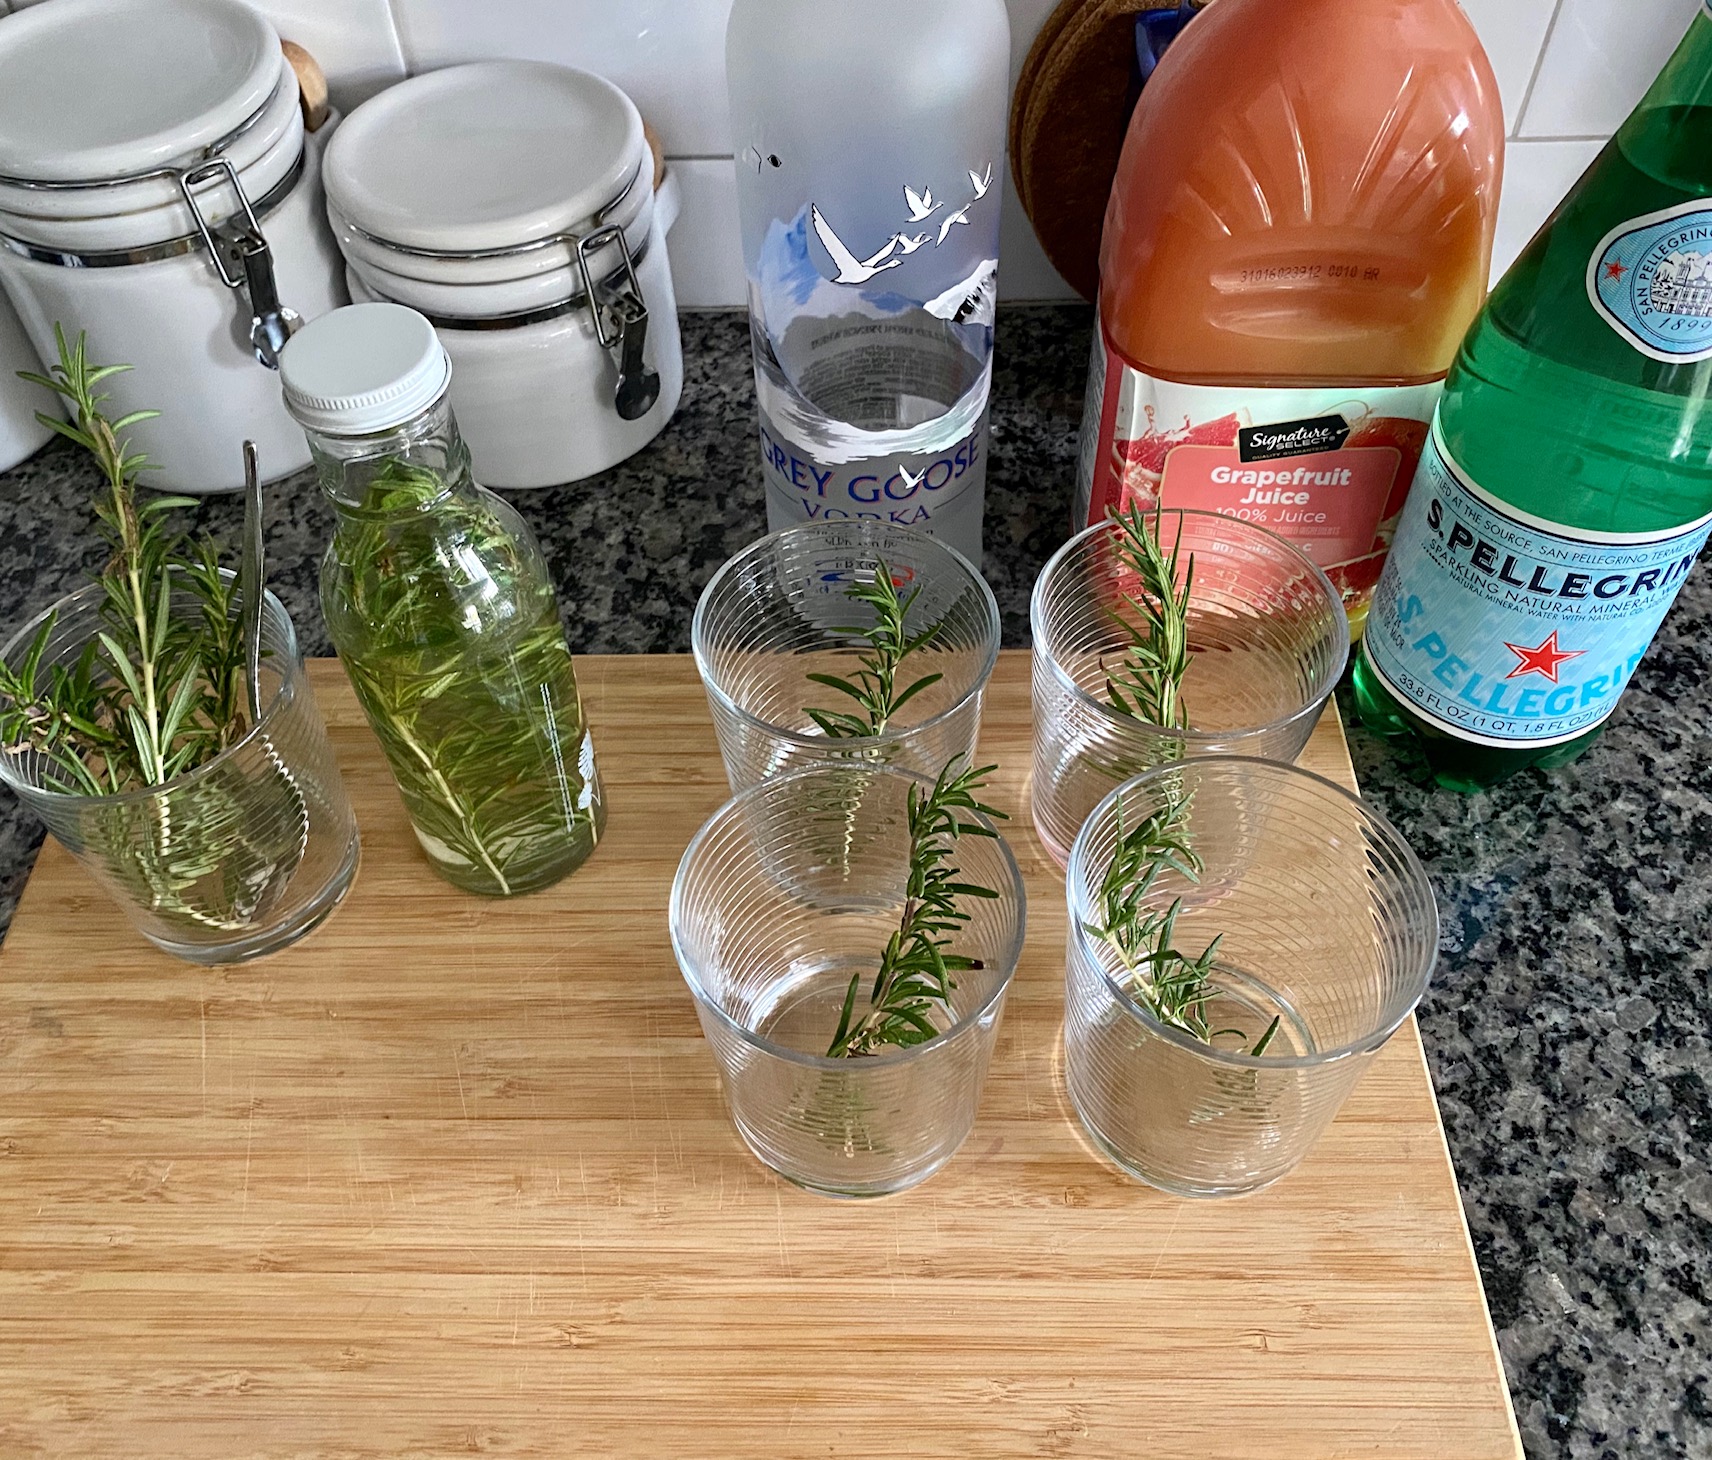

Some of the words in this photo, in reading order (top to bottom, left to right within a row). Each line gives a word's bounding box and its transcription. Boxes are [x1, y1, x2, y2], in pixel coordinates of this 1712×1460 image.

[1639, 228, 1712, 280] PELLEGRIN
[1637, 287, 1653, 316] SAN
[1658, 317, 1712, 332] 1899
[1250, 427, 1331, 450] Signature
[761, 427, 835, 498] GREY
[847, 433, 979, 504] GOOSE
[1210, 466, 1352, 488] Grapefruit
[1240, 487, 1310, 505] Juice
[1274, 509, 1327, 523] Juice
[1427, 498, 1700, 601] S.PELLEGRIN
[1452, 496, 1463, 508] AT
[1464, 504, 1483, 523] THE
[1484, 520, 1533, 552] SOURCE,
[1539, 546, 1569, 560] SAN
[1571, 552, 1648, 565] PELLEGRINO
[1652, 543, 1686, 561] TERME
[1430, 538, 1499, 593] SPARKLING
[1505, 590, 1582, 614] NATURAL
[1589, 594, 1656, 614] MINERAL
[1449, 571, 1483, 597] NATURAL
[1485, 594, 1523, 613] MINERAL
[1528, 609, 1559, 620] WATER
[1588, 612, 1626, 622] NATURAL
[1397, 594, 1646, 717] S.PELLEGRIN
[1399, 673, 1424, 697] 33.8
[1427, 693, 1442, 711] FL
[1447, 706, 1470, 721] OZ
[1472, 715, 1486, 727] (1
[1491, 720, 1517, 733] QT,
[1524, 723, 1545, 733] 1.8
[1548, 721, 1566, 731] FL
[1569, 711, 1593, 726] OZ)
